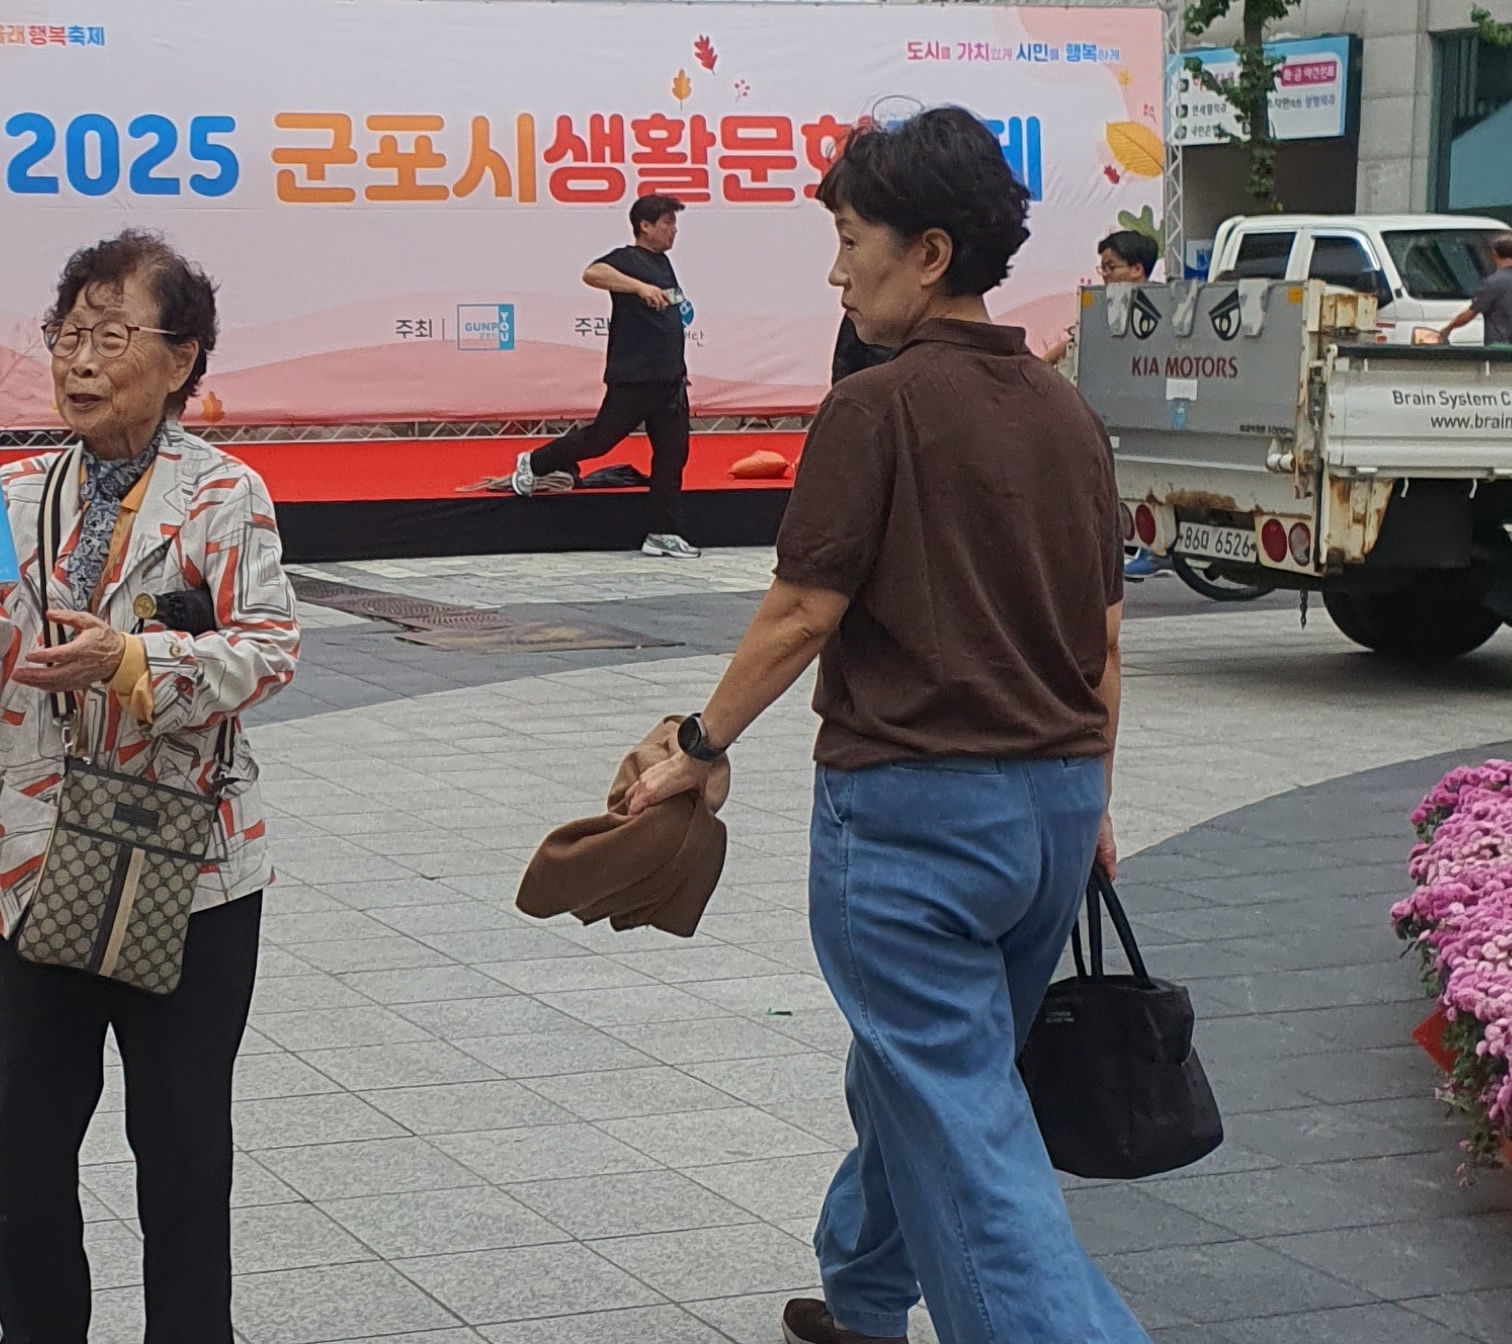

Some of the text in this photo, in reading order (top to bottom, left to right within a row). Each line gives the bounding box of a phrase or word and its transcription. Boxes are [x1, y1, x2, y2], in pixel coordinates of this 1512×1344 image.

[4, 111, 240, 198] 2025
[394, 318, 433, 339] 주최
[574, 316, 611, 338] 주관
[1131, 355, 1238, 378] KIA MOTORS
[1392, 389, 1436, 406] Brain
[1438, 389, 1498, 410] System
[1215, 530, 1251, 558] 6526
